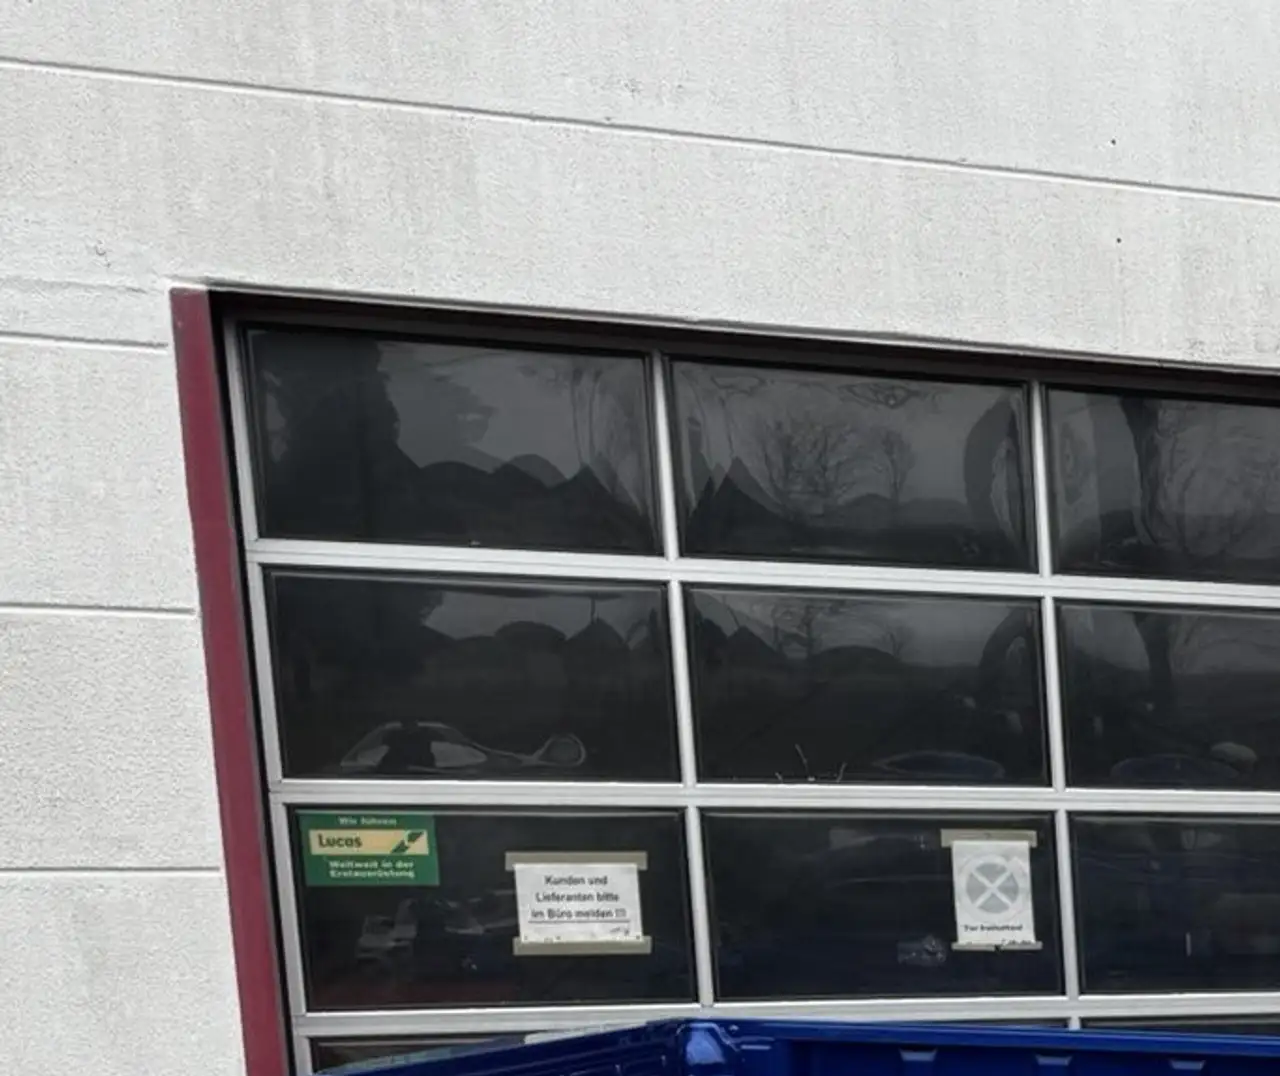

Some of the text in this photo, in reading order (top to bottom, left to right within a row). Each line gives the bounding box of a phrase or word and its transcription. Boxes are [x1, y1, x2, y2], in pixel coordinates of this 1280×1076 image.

[318, 833, 363, 848] Lucas
[544, 875, 608, 885] Kunden und
[535, 892, 619, 902] Lieferanten bitte
[547, 908, 573, 918] Büro
